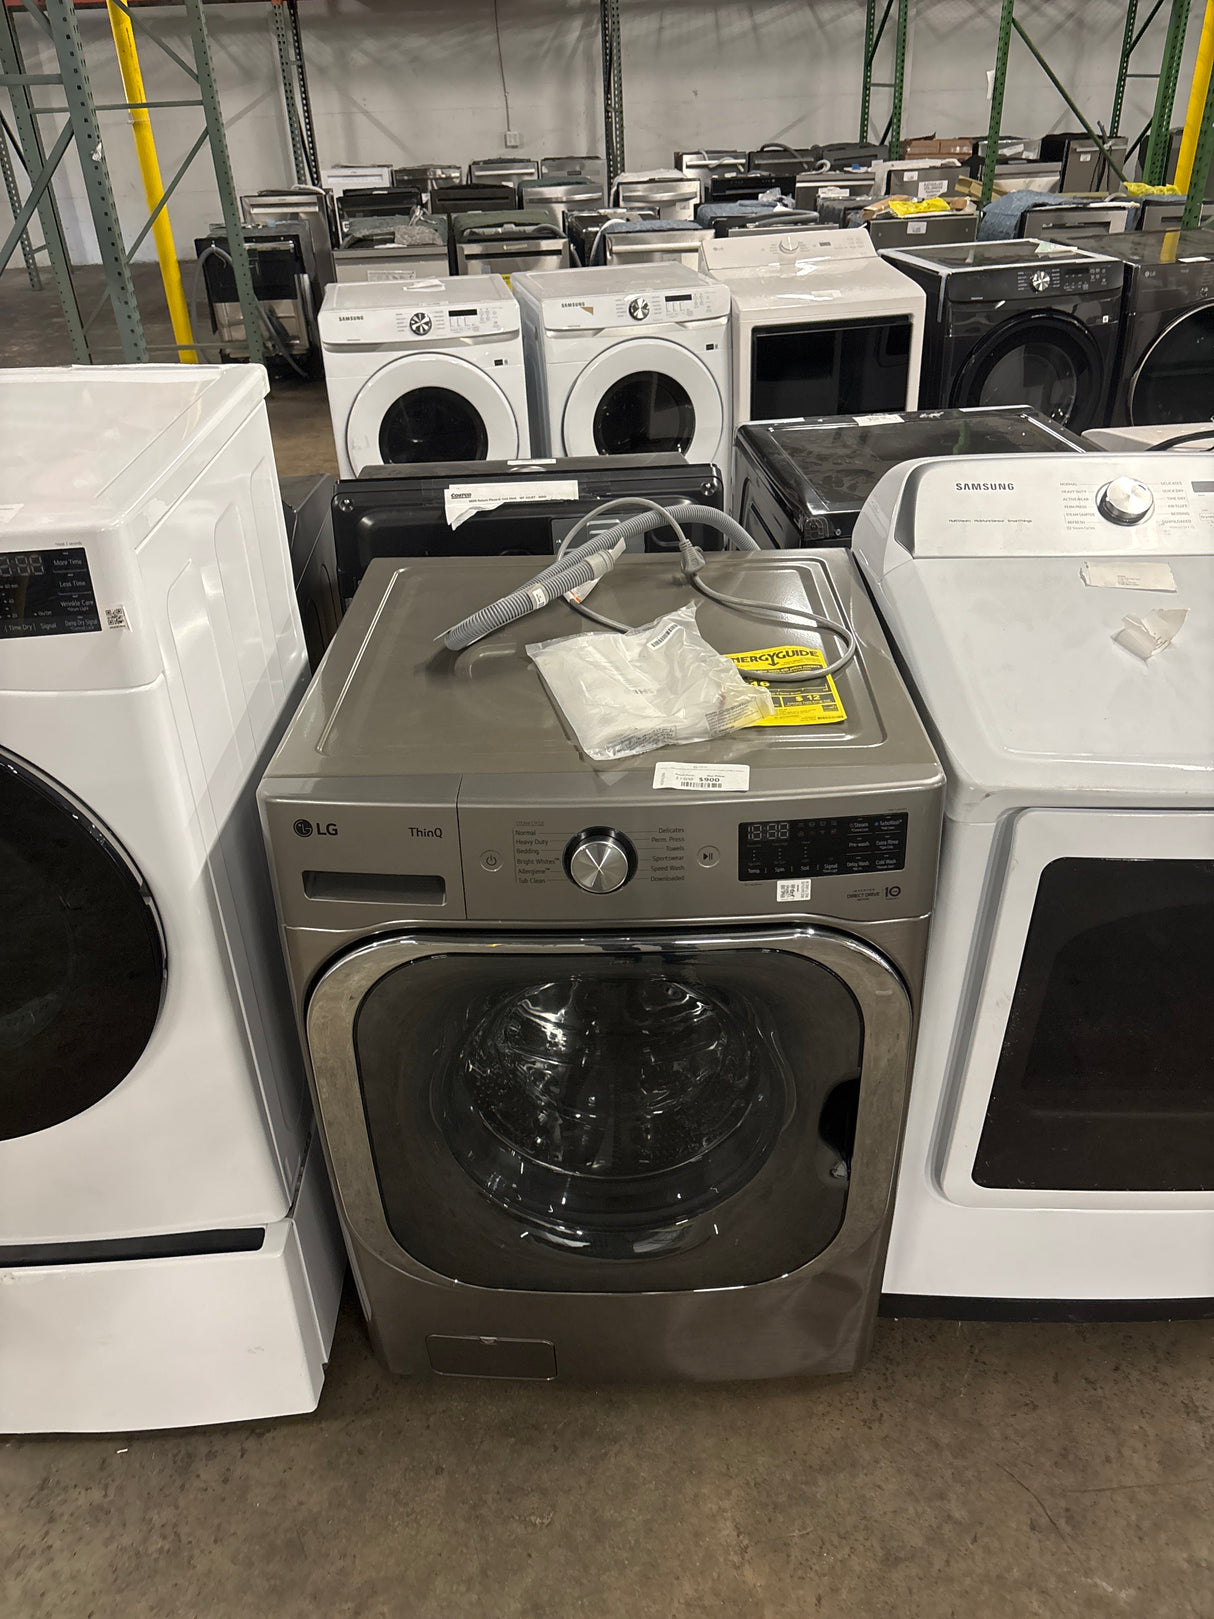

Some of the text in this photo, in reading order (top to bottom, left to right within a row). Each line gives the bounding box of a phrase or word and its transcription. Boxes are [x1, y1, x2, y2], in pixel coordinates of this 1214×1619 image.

[731, 650, 819, 666] NERGYGUIDE
[316, 823, 338, 836] LG
[408, 827, 443, 839] ThinQ
